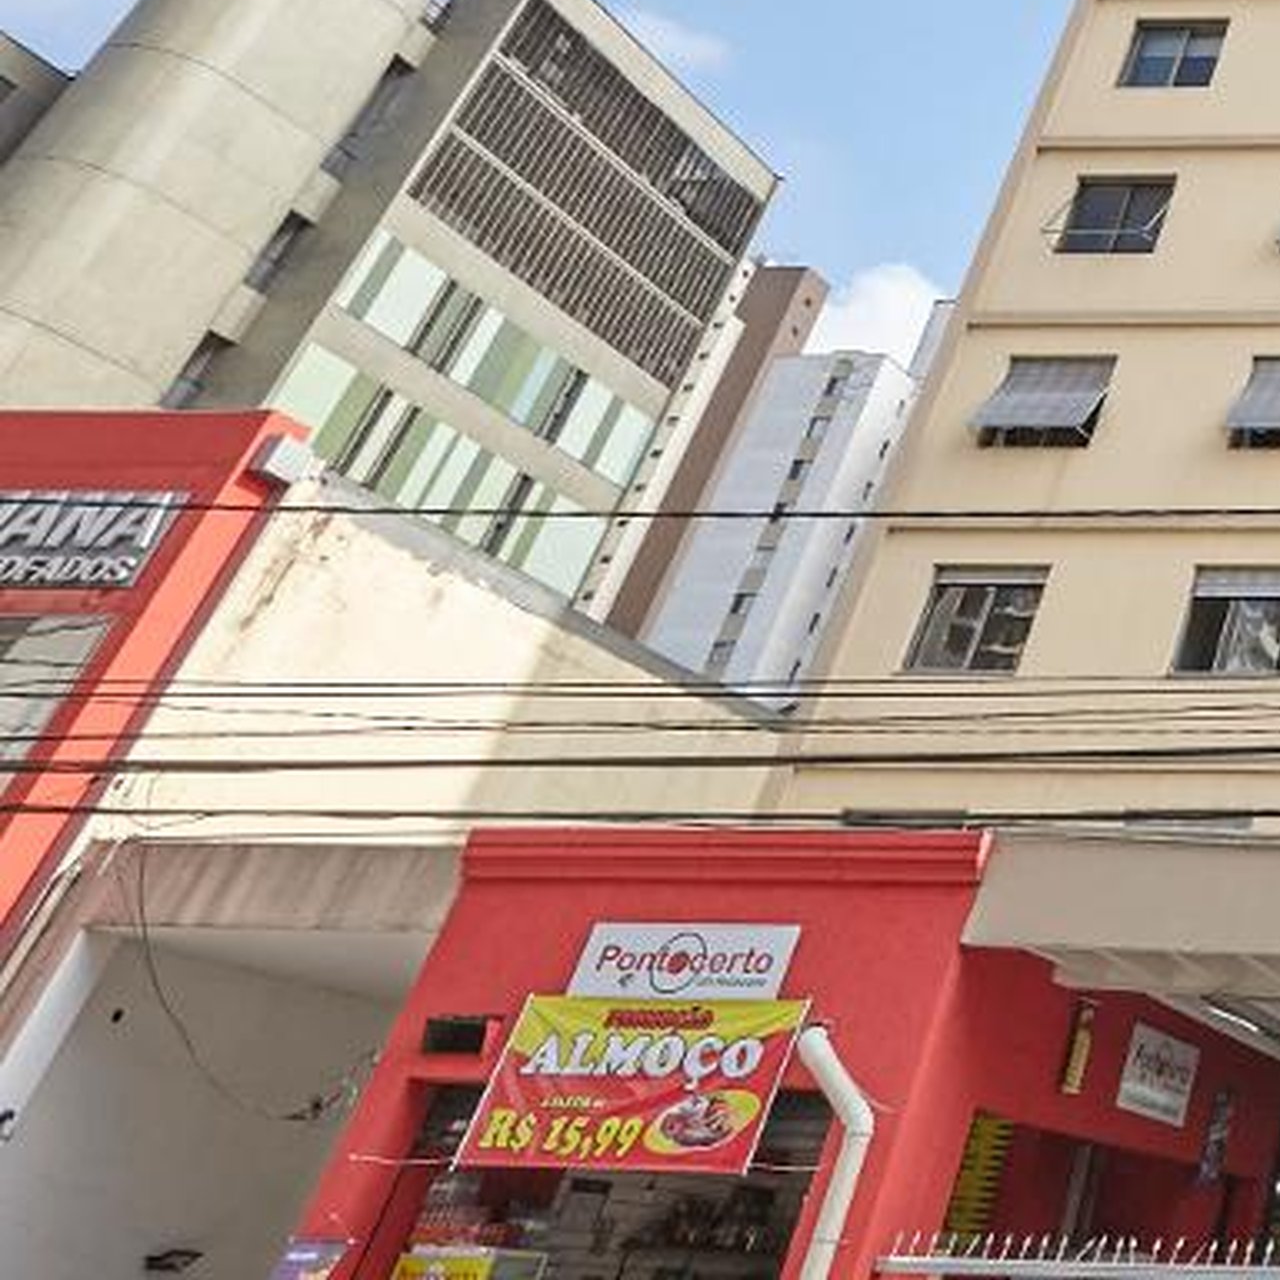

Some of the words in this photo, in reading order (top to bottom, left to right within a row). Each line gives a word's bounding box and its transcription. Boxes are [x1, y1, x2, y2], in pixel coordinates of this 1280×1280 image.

[520, 1032, 764, 1091] ALMOÇO
[478, 1106, 537, 1152] R$
[541, 1116, 646, 1161] 15,99
